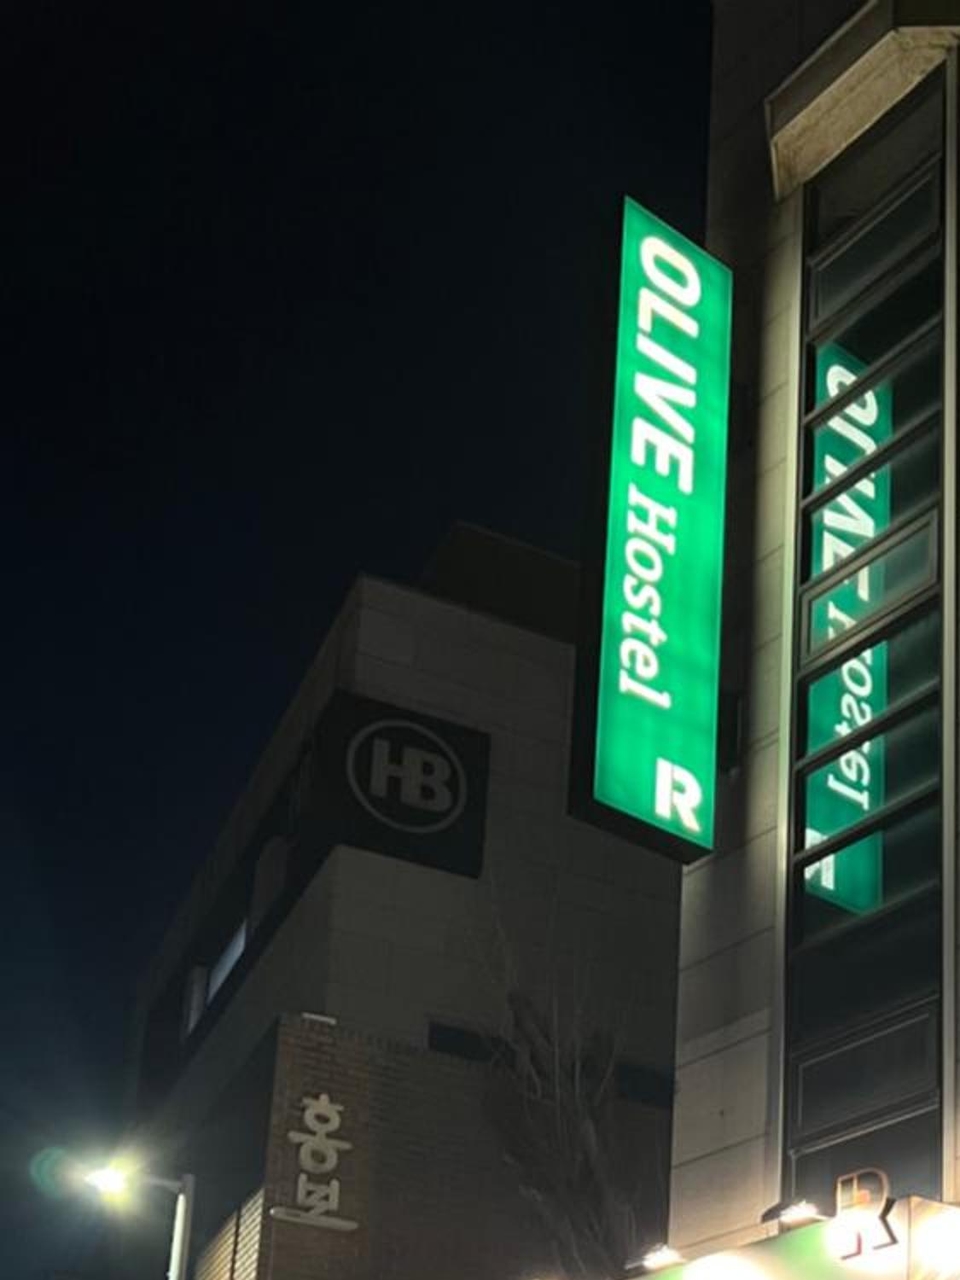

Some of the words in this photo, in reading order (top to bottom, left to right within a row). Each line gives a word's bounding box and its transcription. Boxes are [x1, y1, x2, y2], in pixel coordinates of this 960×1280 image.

[630, 235, 702, 495] OLIVE
[619, 482, 678, 710] Hostel
[370, 737, 453, 811] HB
[655, 757, 703, 832] R
